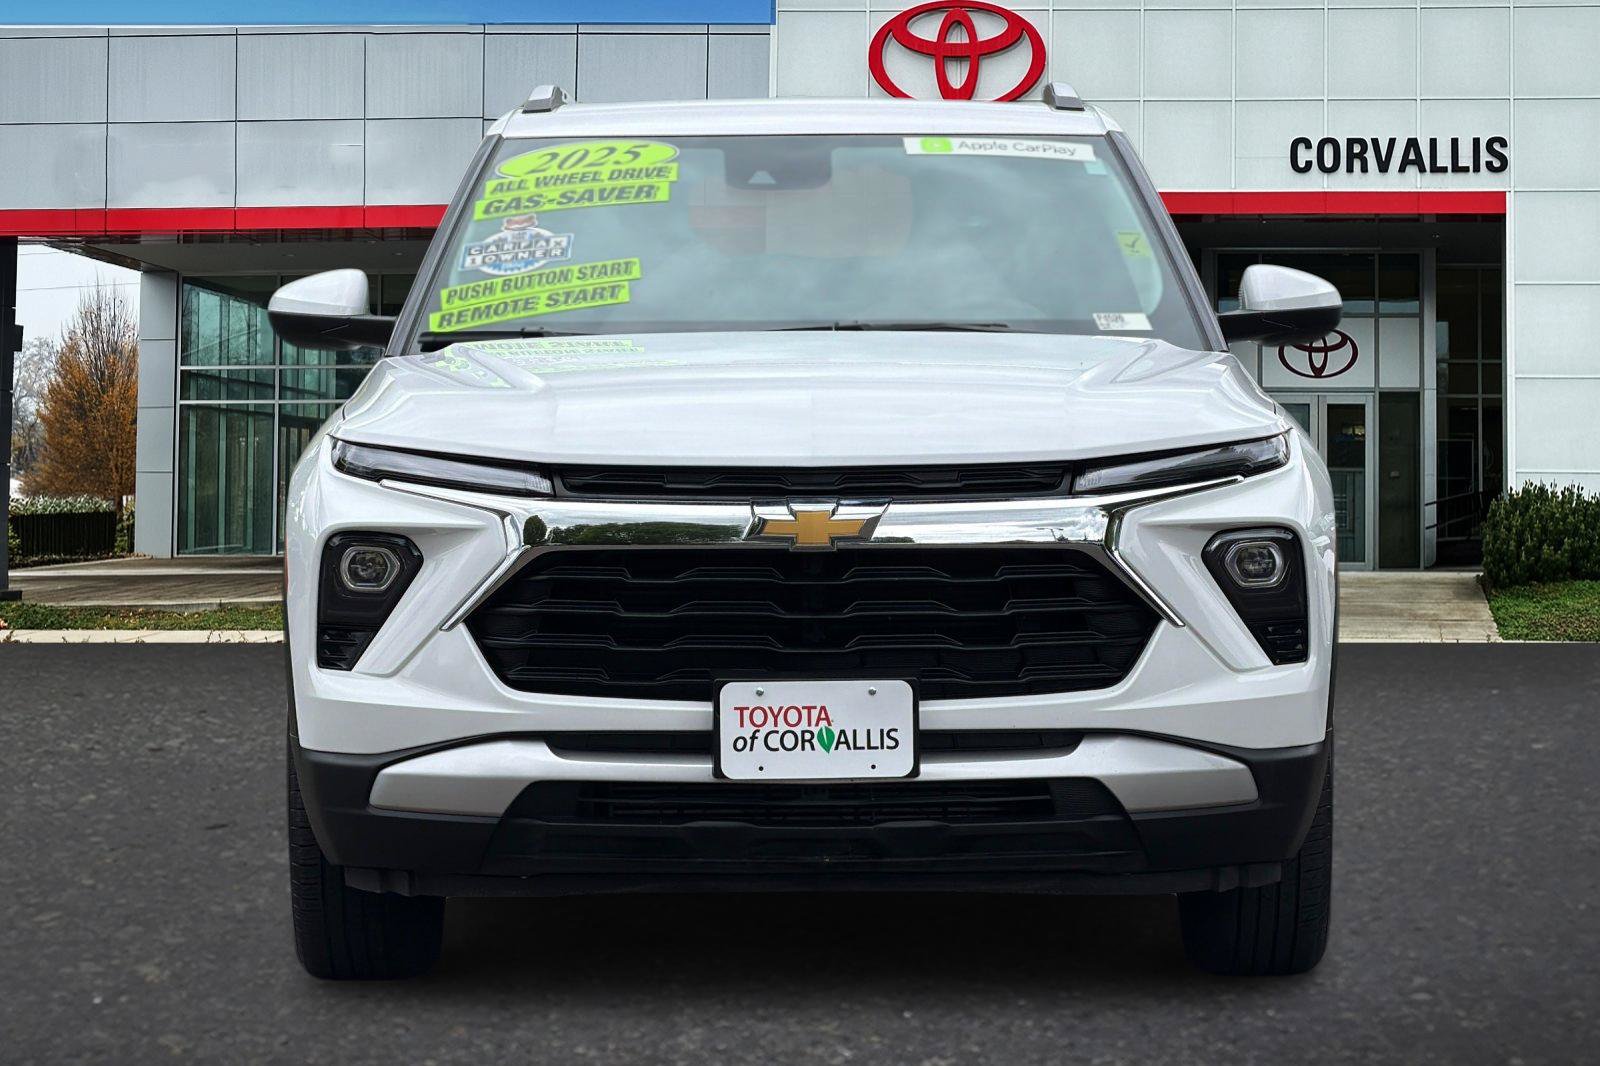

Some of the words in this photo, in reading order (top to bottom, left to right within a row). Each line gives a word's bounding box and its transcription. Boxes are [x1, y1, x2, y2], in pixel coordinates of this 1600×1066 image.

[527, 144, 650, 174] 2025
[957, 141, 1008, 155] Apple
[1012, 142, 1077, 156] CarPlay
[1290, 136, 1508, 174] CORVALLIS
[490, 178, 529, 195] ALL
[534, 171, 603, 188] WHEEL
[608, 165, 671, 182] DRIVE
[482, 184, 661, 216] GAS-SAVER
[446, 277, 498, 304] PUSH
[500, 267, 573, 292] BUTTON
[576, 260, 637, 281] START
[438, 295, 541, 328] REMOTE
[545, 284, 625, 308] START
[733, 705, 832, 728] TOYOTA
[733, 729, 760, 752] of
